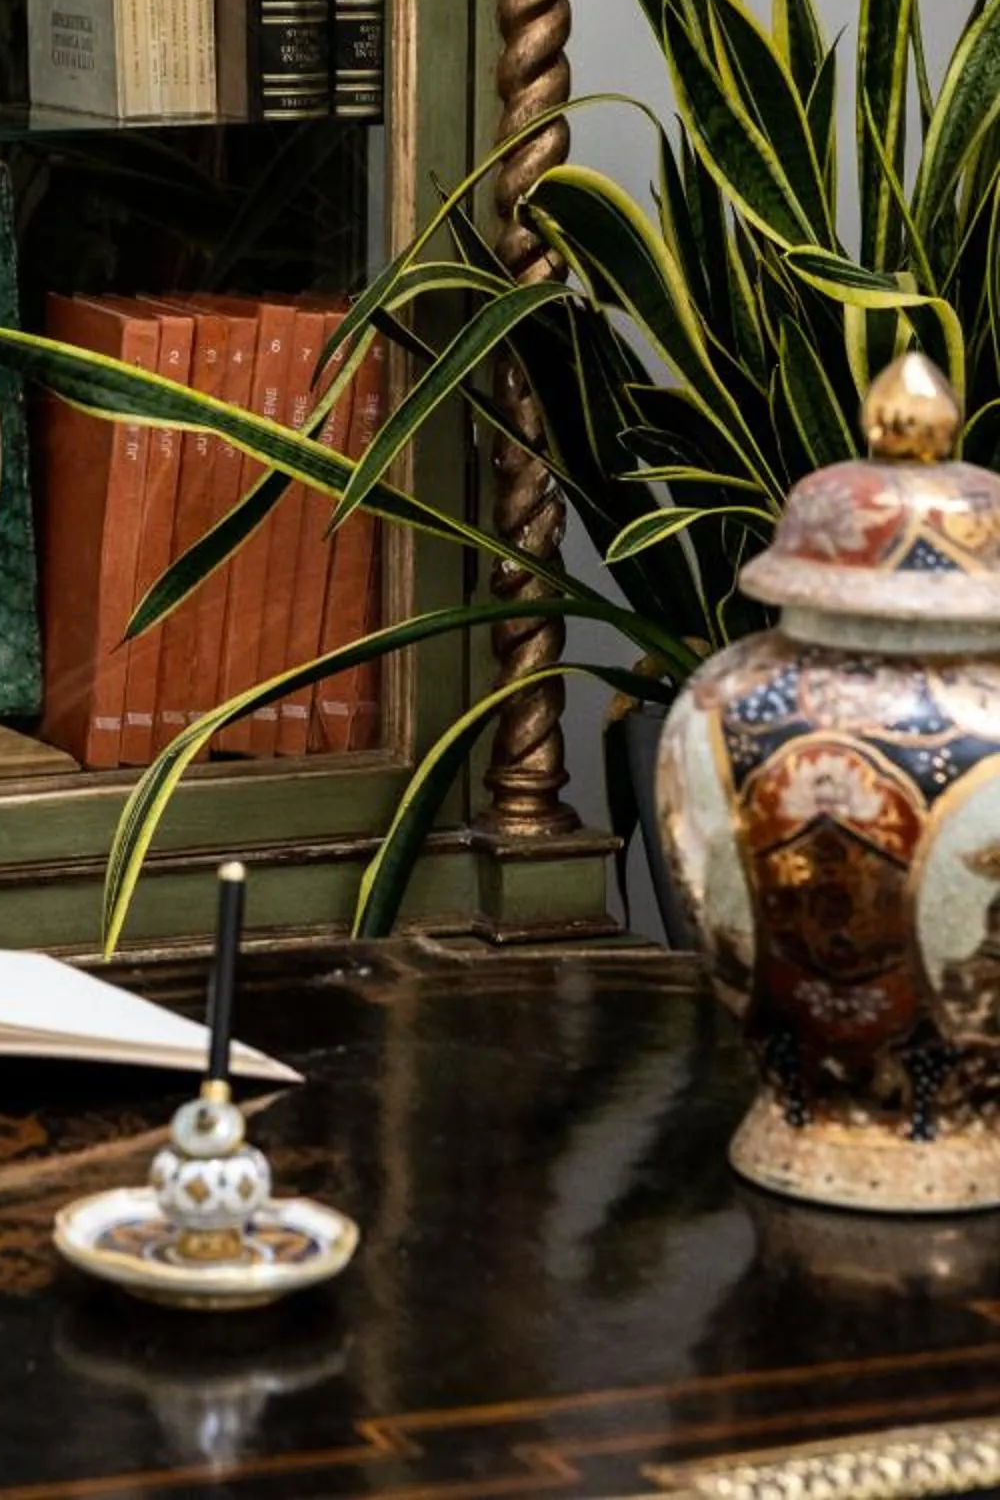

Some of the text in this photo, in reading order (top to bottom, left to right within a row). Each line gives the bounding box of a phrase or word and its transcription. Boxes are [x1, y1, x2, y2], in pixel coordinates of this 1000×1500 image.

[271, 339, 281, 353] 6
[169, 348, 181, 365] 2
[233, 349, 242, 365] 4
[301, 347, 312, 361] 7
